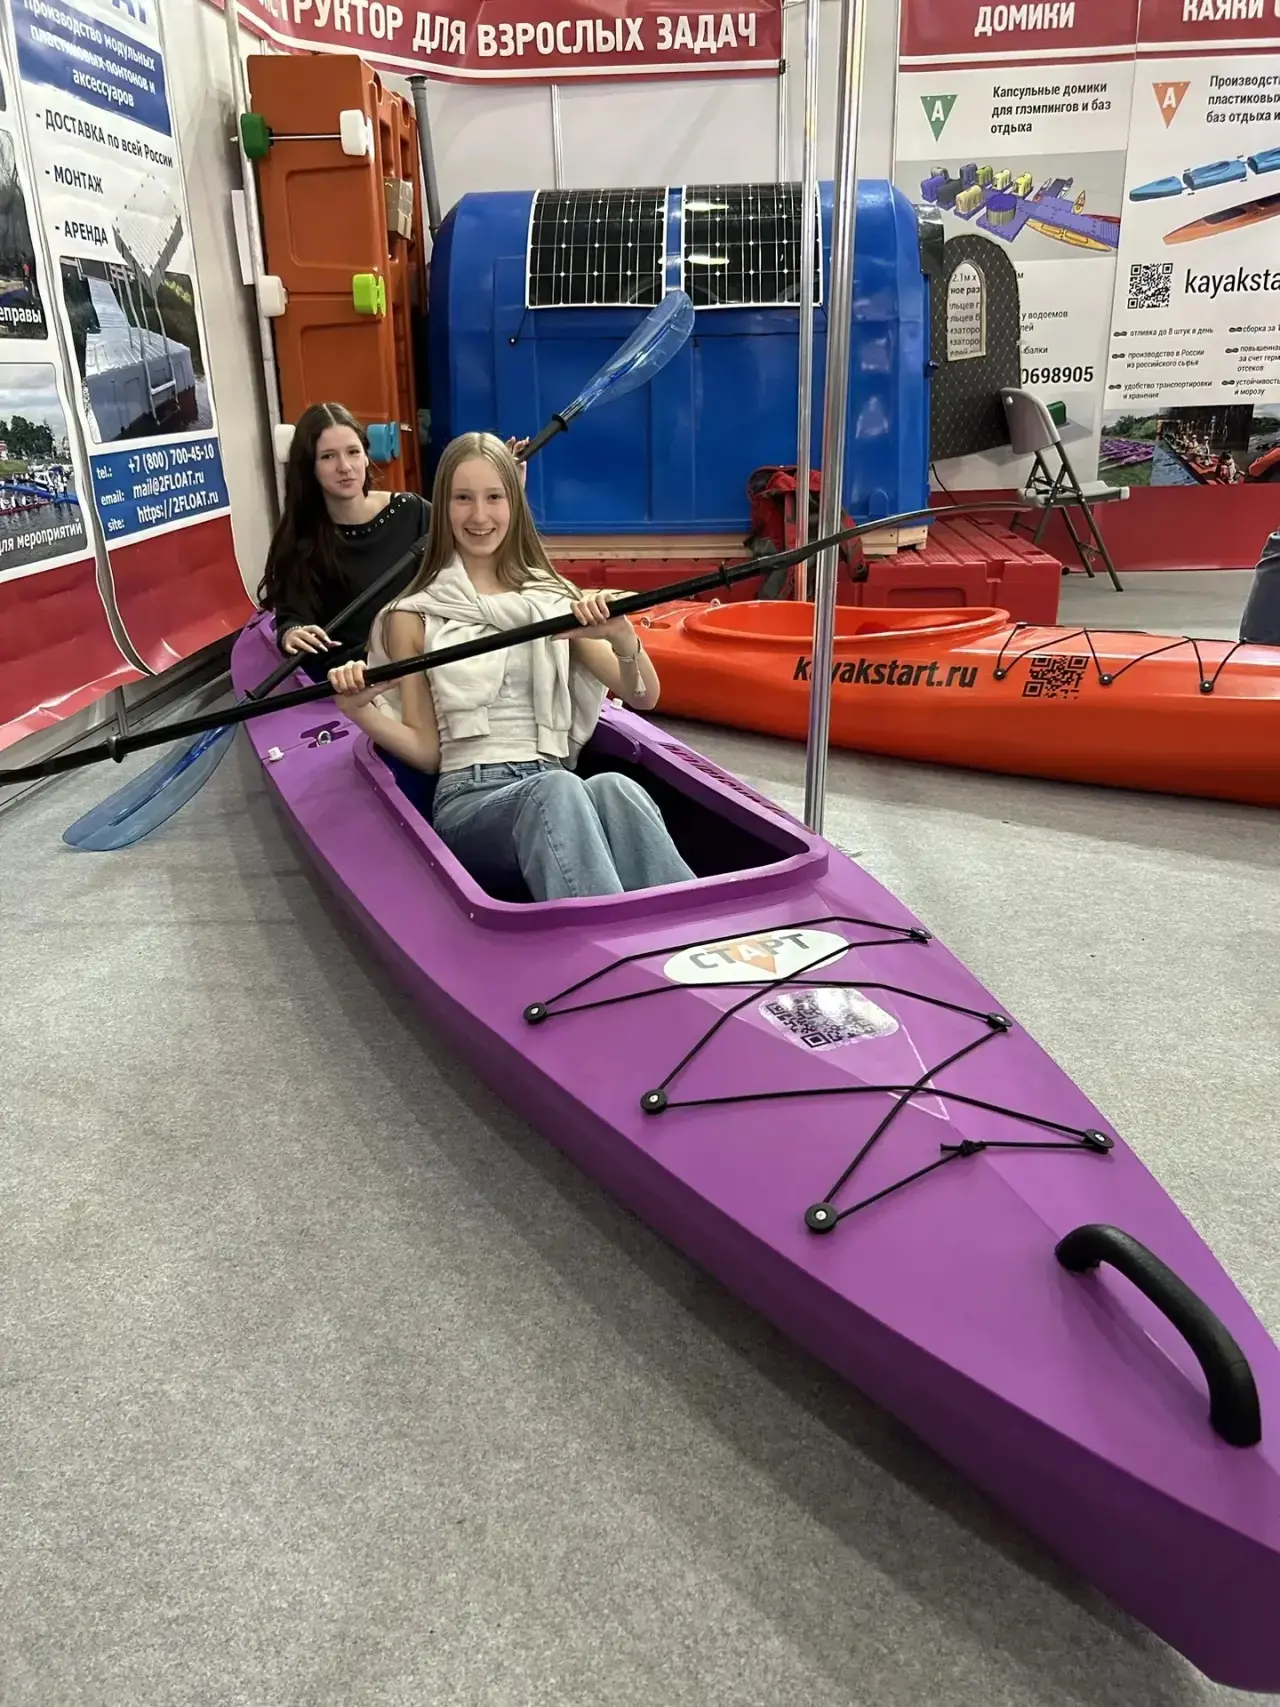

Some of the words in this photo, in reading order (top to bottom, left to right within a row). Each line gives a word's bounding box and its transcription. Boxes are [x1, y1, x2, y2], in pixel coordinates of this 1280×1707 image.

[974, 2, 1076, 37] ДОМИКИ
[1182, 0, 1264, 21] КАЯКИ
[412, 11, 466, 55] ДЛЯ
[477, 17, 645, 57] ВЗРОСЛЫХ
[655, 12, 757, 55] ЗАДАЧ
[72, 69, 135, 108] аксессуаров
[993, 85, 1061, 100] Капсульные
[1062, 83, 1107, 97] домики
[1209, 75, 1280, 89] Производст
[991, 106, 1013, 118] для
[1015, 102, 1079, 115] глэмпингов
[1081, 103, 1089, 111] и
[1091, 98, 1111, 111] баз
[1206, 110, 1225, 123] баз
[1228, 112, 1271, 124] отдыха
[45, 109, 106, 144] ДОСТАВКА
[107, 134, 120, 149] по
[121, 139, 143, 157] всей
[143, 143, 174, 168] России
[990, 123, 1032, 135] отдыха
[53, 165, 104, 194] МОНТАЖ
[64, 220, 109, 247] АРЕНДА
[128, 455, 140, 473] +7
[142, 451, 169, 474] (800)
[170, 443, 215, 465] 700-45-10
[101, 490, 125, 506] email:
[133, 471, 205, 499] mail@2FLOAT.ru
[137, 491, 219, 523] https://2FLOAT.ru
[0, 537, 14, 556] ля
[16, 518, 83, 549] мероприятий
[793, 656, 978, 688] kyakstart.ru
[689, 933, 811, 969] СТАРТ
